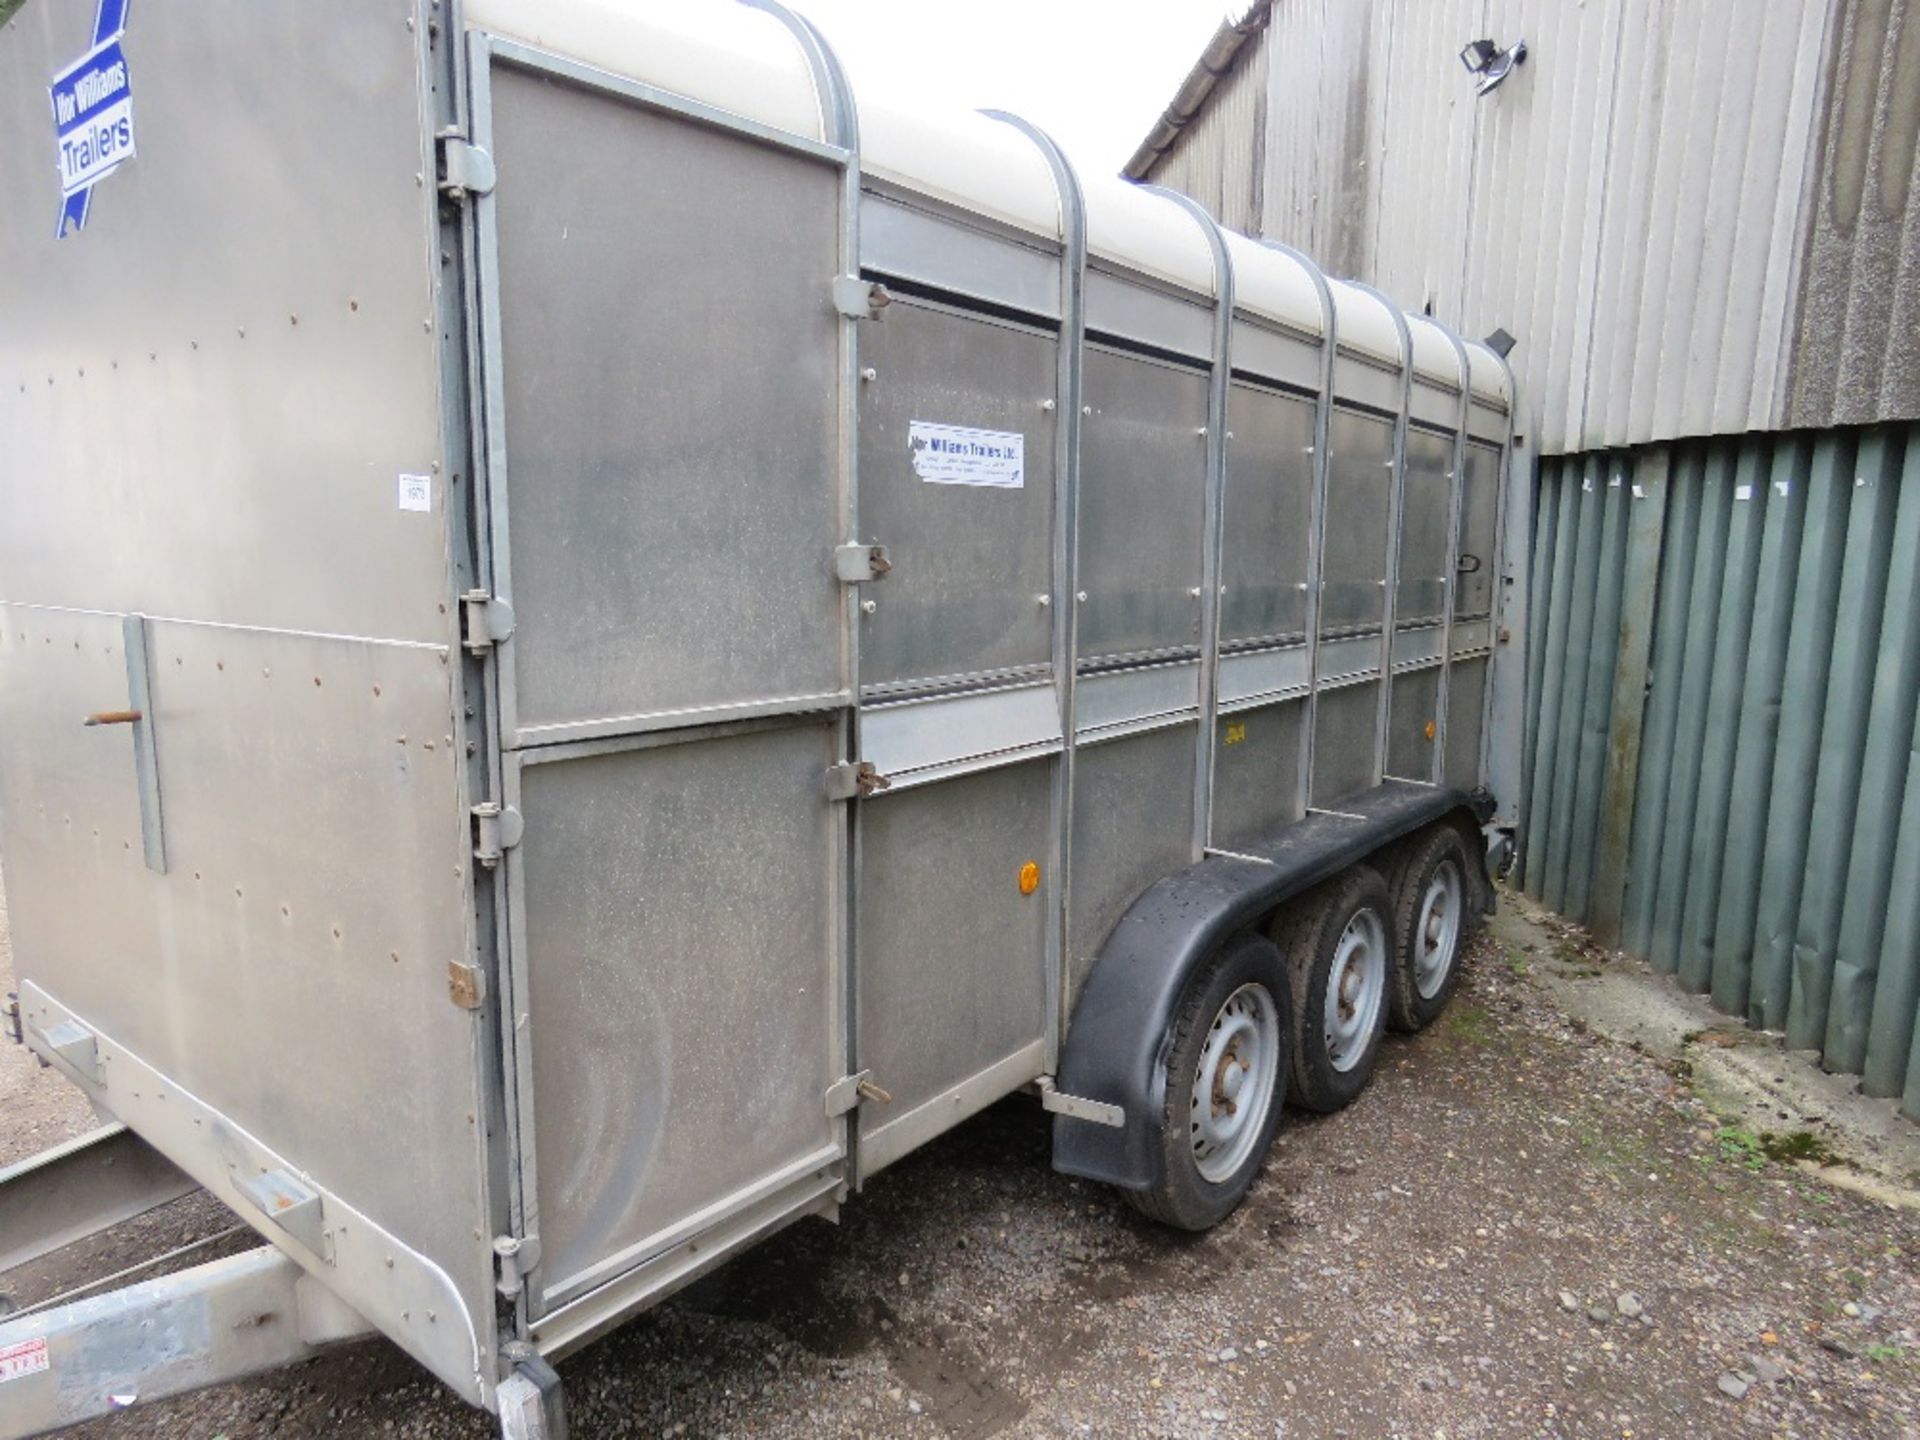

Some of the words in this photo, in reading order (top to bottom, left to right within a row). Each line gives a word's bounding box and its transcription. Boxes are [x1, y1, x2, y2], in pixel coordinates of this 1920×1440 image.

[73, 60, 126, 115] Williams
[62, 116, 130, 177] Trailers
[931, 438, 968, 455] Williams
[969, 442, 1001, 459] Trailers
